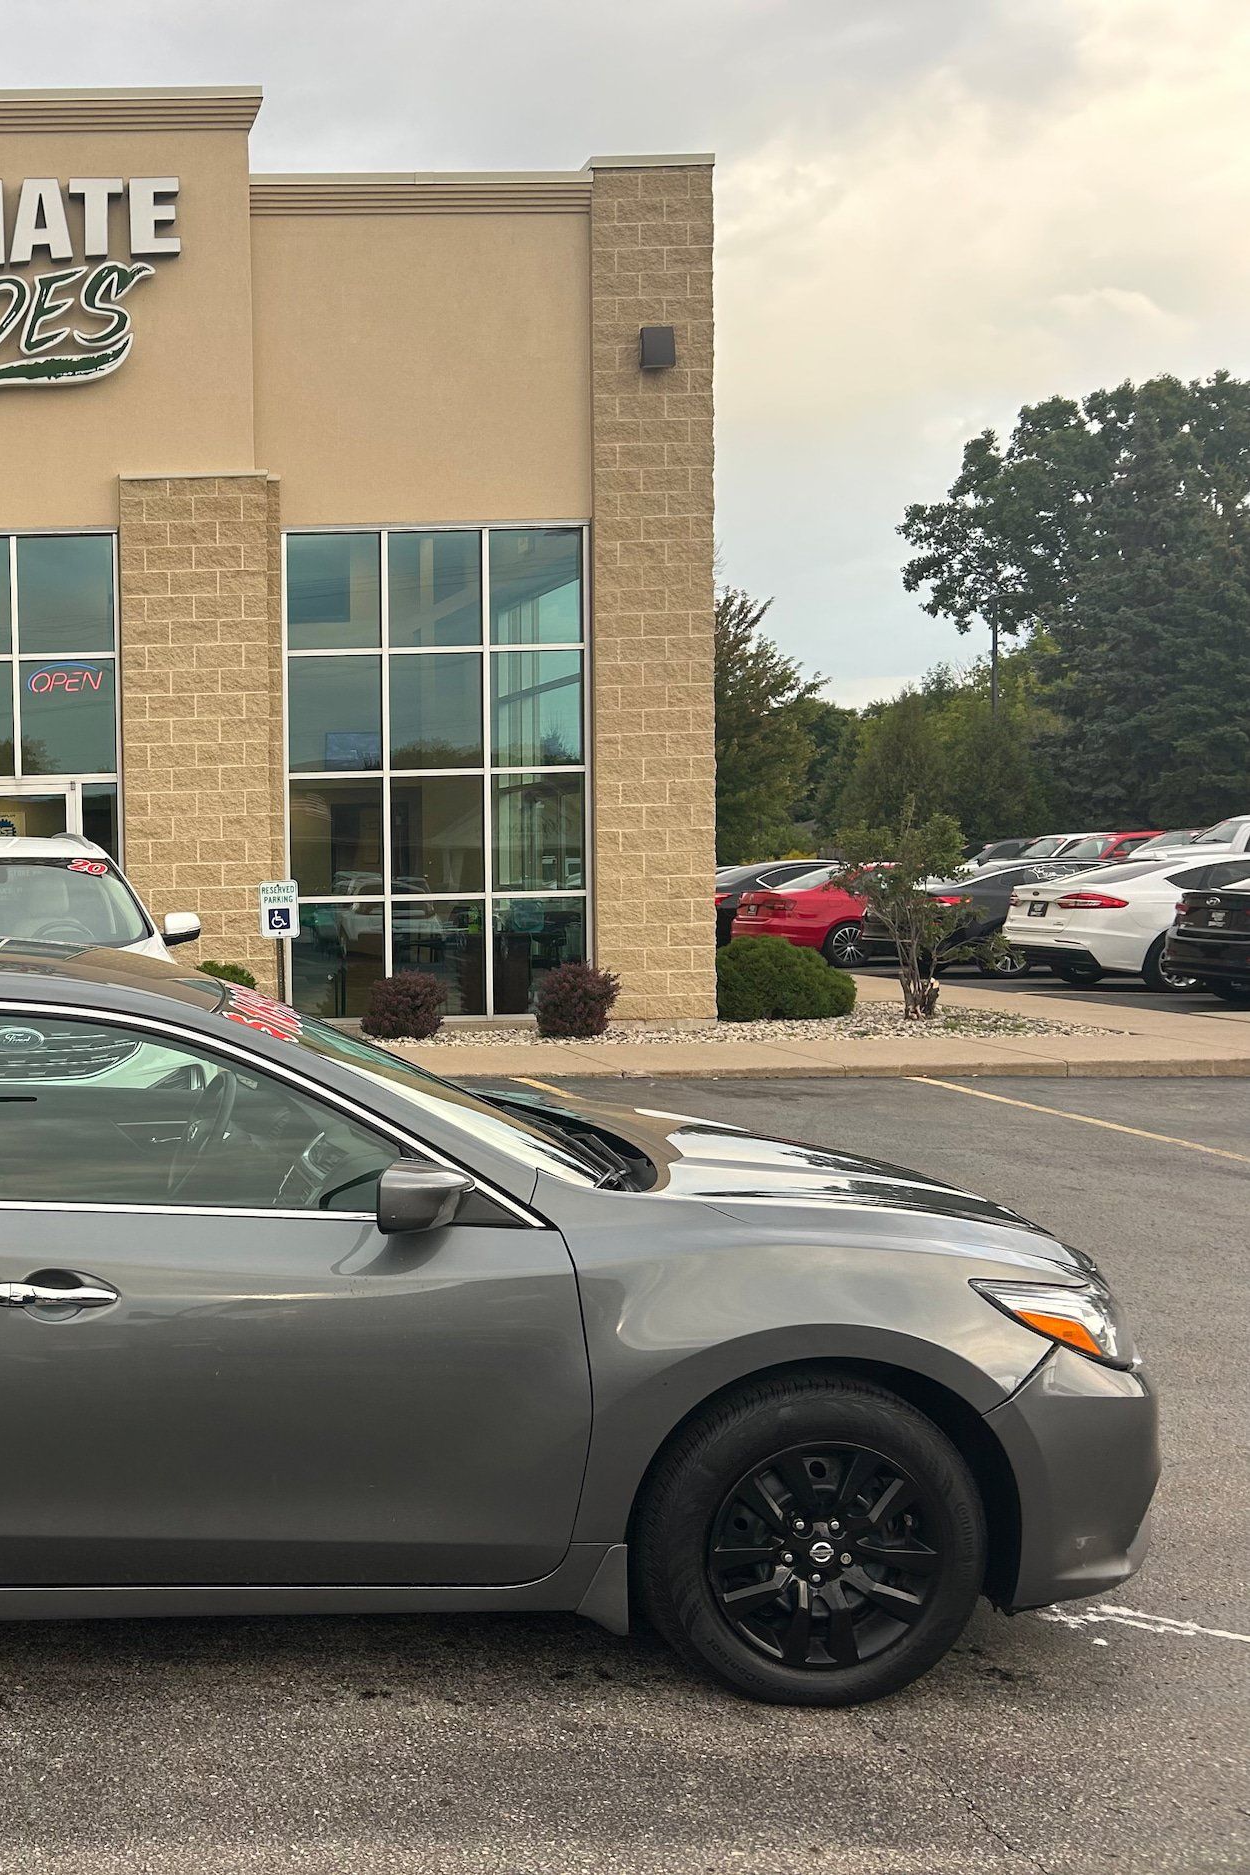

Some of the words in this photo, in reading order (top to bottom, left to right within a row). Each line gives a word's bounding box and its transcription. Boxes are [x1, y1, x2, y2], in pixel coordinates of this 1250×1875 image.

[31, 671, 103, 693] OPEN
[66, 858, 108, 875] 20
[262, 885, 295, 894] RESERVED
[264, 895, 294, 903] PARKING
